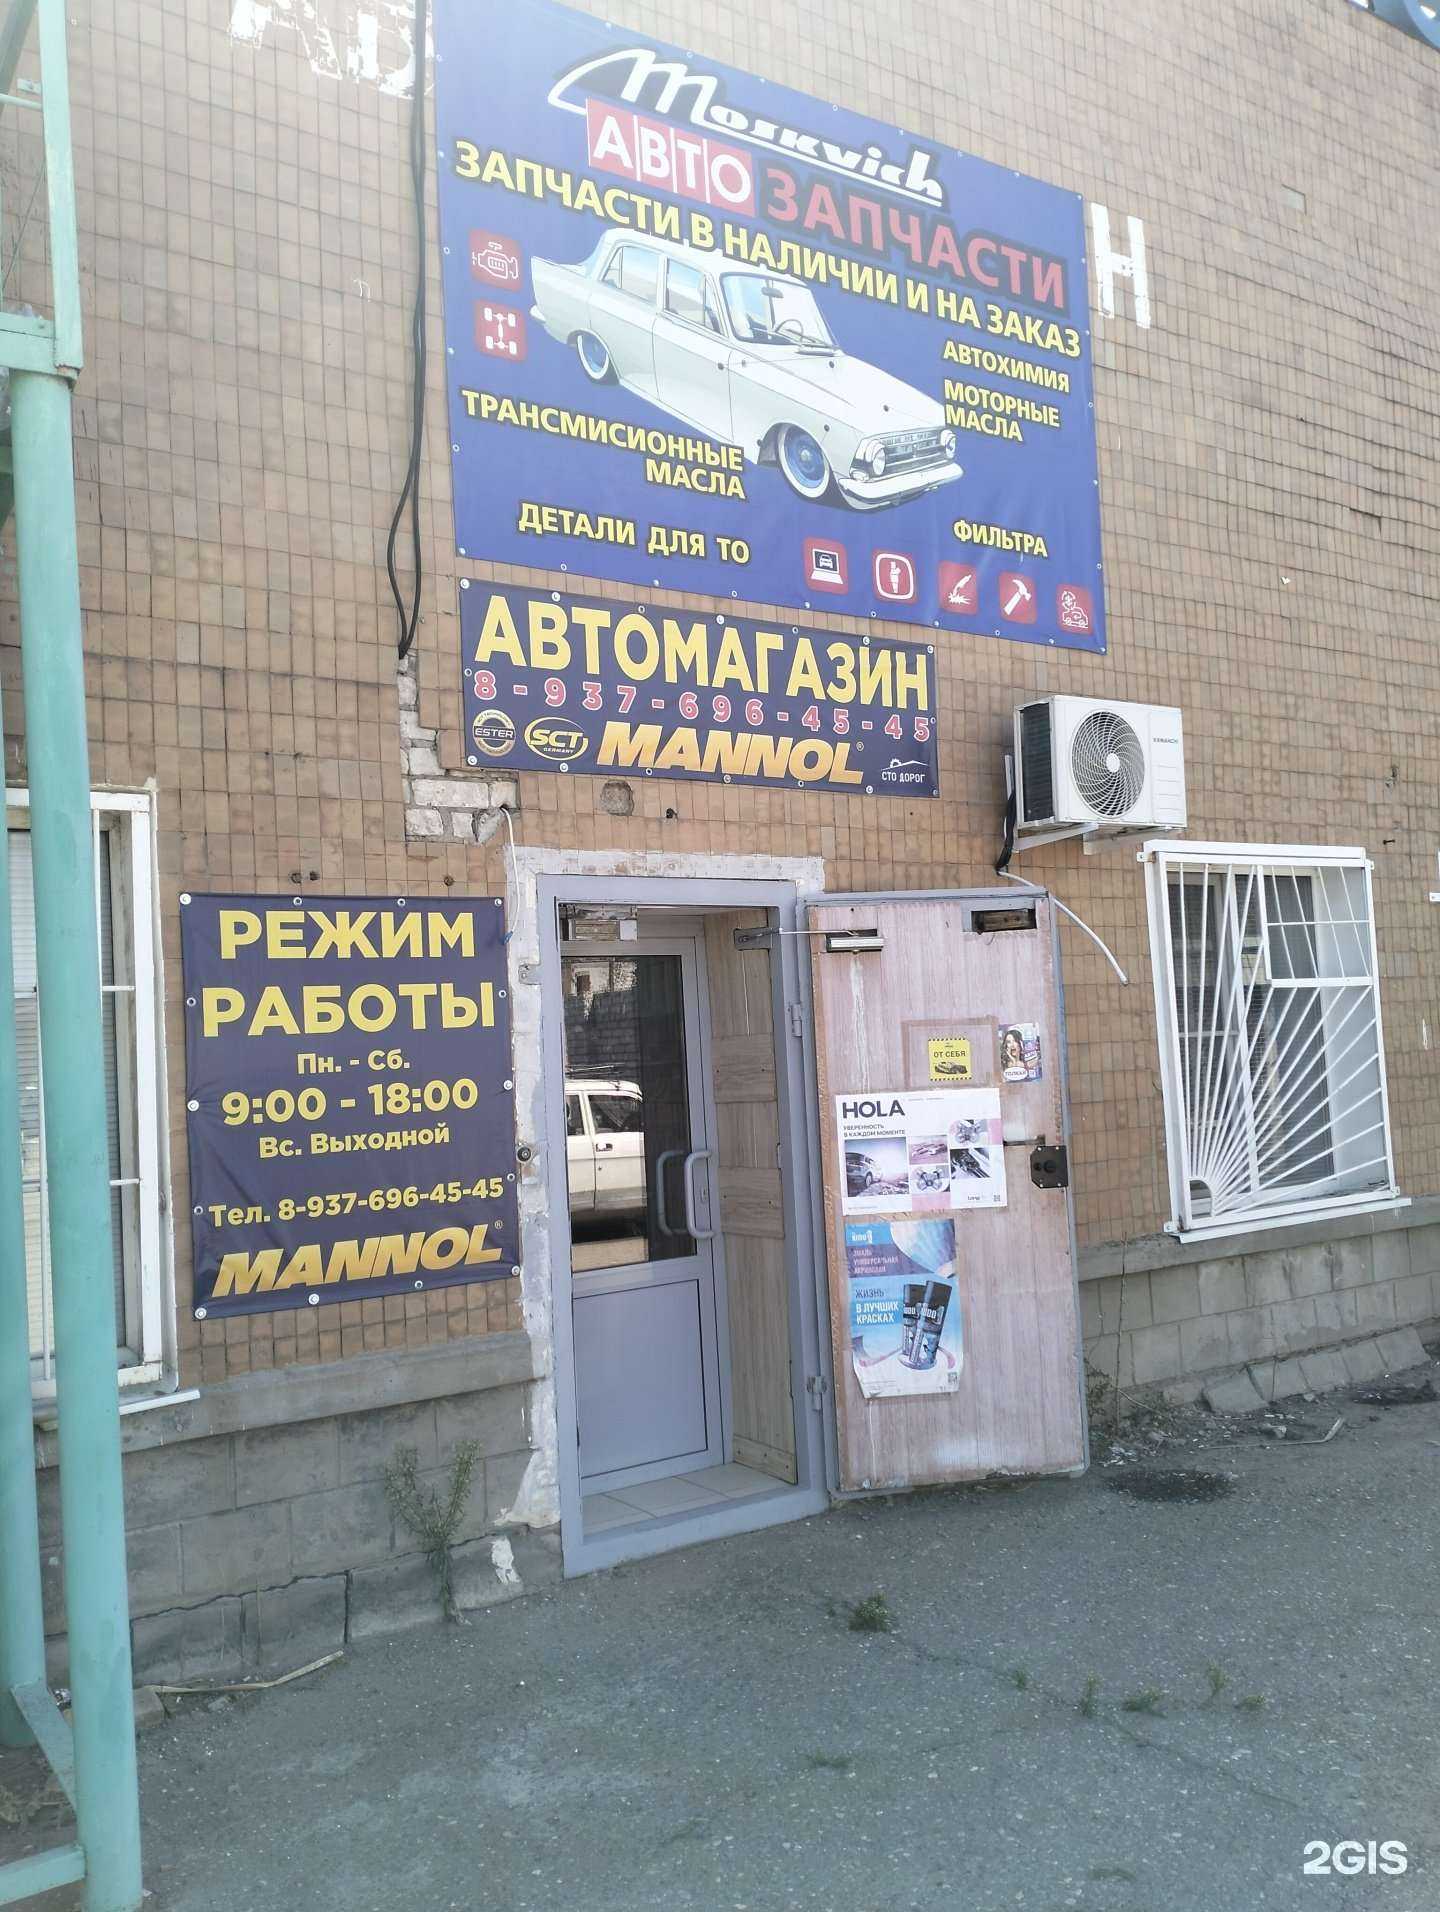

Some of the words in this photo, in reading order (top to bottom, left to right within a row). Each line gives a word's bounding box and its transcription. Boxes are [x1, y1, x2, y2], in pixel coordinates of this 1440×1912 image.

[548, 48, 945, 208] Moskvich
[454, 140, 681, 244] ЗАПЧАСТИ
[691, 212, 715, 250] В
[723, 221, 897, 304] НАЛИЧИИ
[906, 270, 929, 312] И
[936, 288, 980, 329] НА
[986, 303, 1081, 358] ЗАКАЗ
[943, 340, 1070, 394] АВТОХИМИЯ
[943, 378, 1060, 429] МОТОРНЫЕ
[945, 404, 1024, 443] МАСЛА
[461, 388, 745, 472] ТРАНСМИСИОННЫЕ
[645, 457, 746, 500] МАСЛА
[517, 502, 636, 546] ДЕТАЛИ
[647, 526, 707, 558] ДЛЯ
[716, 537, 751, 564] ТО
[952, 519, 1048, 558] ФИЛЬТРА
[474, 594, 928, 711] АВТОМАГАЗИН
[475, 727, 514, 739] ESTER
[529, 728, 583, 749] SCT
[881, 771, 897, 782] СТО
[899, 772, 926, 784] ДОРОГ
[219, 910, 475, 959] РЕЖИМ
[202, 982, 494, 1037] РАБОТЫ
[297, 1052, 342, 1074] Пн.
[367, 1048, 410, 1070] Сб.
[945, 1050, 966, 1058] СЕБЯ
[222, 1087, 326, 1126] 9:00
[368, 1078, 478, 1116] 18:00
[842, 1100, 905, 1118] HOLA
[259, 1136, 302, 1158] Вс.
[311, 1122, 449, 1155] Выходной
[208, 1203, 270, 1228] Тел.
[278, 1178, 504, 1222] 8-937-696-45-45
[855, 1288, 884, 1298] ЖИЗНЬ
[856, 1303, 861, 1313] В
[863, 1301, 899, 1312] ЛУЧШИХ
[856, 1313, 895, 1325] КРАСКАХ
